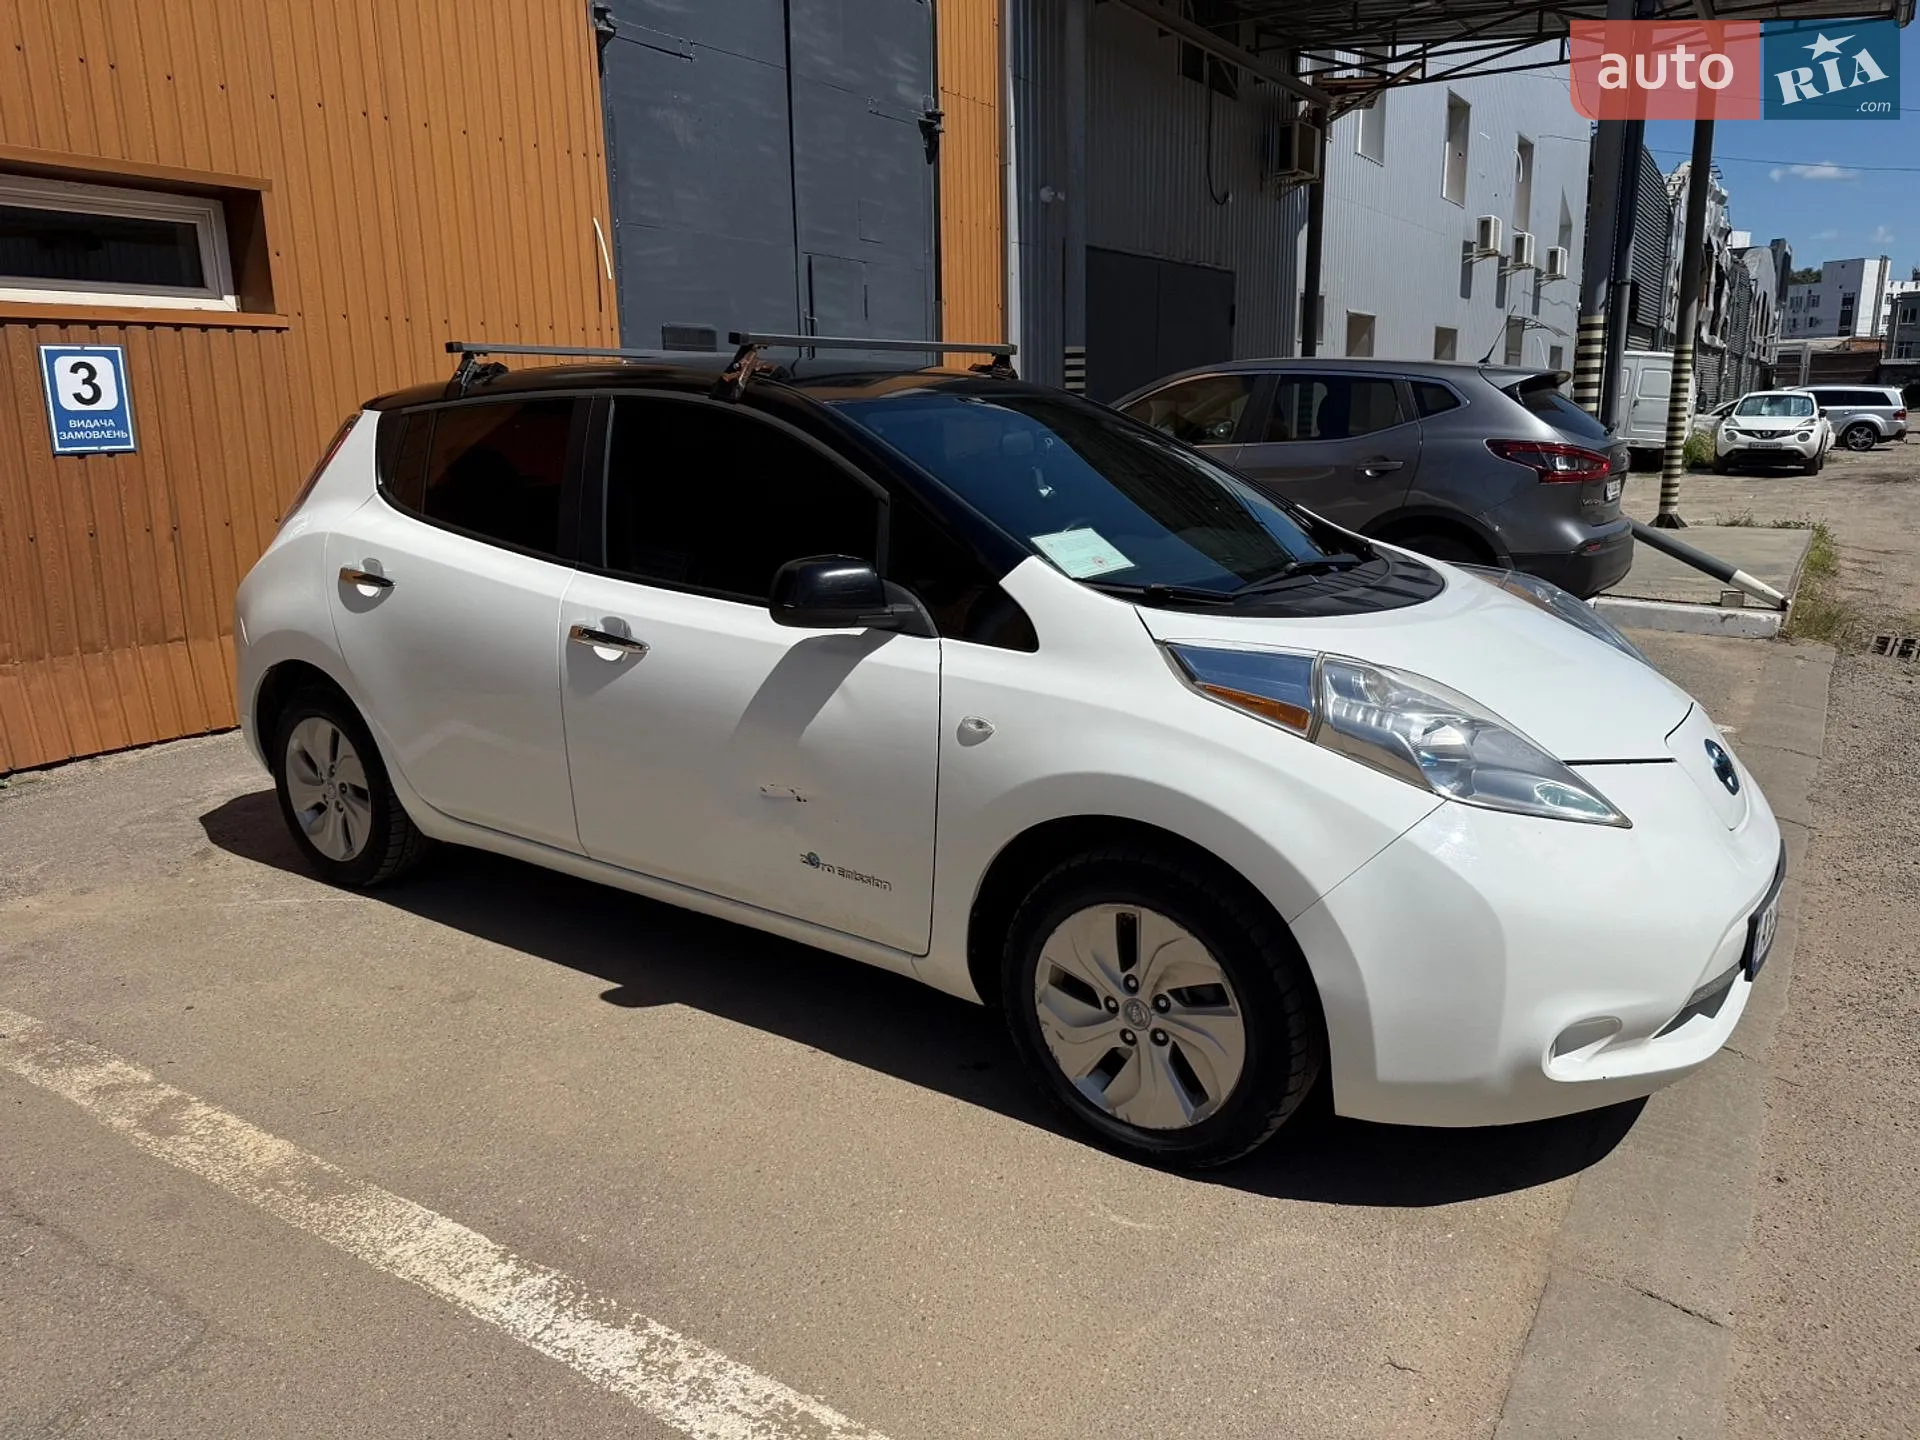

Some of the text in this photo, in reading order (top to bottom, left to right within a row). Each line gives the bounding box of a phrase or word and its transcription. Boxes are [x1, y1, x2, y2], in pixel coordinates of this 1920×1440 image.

[69, 361, 102, 407] 3
[69, 418, 116, 429] ВИДАЧА
[59, 430, 128, 440] ЗАМОВЛЕНЬ
